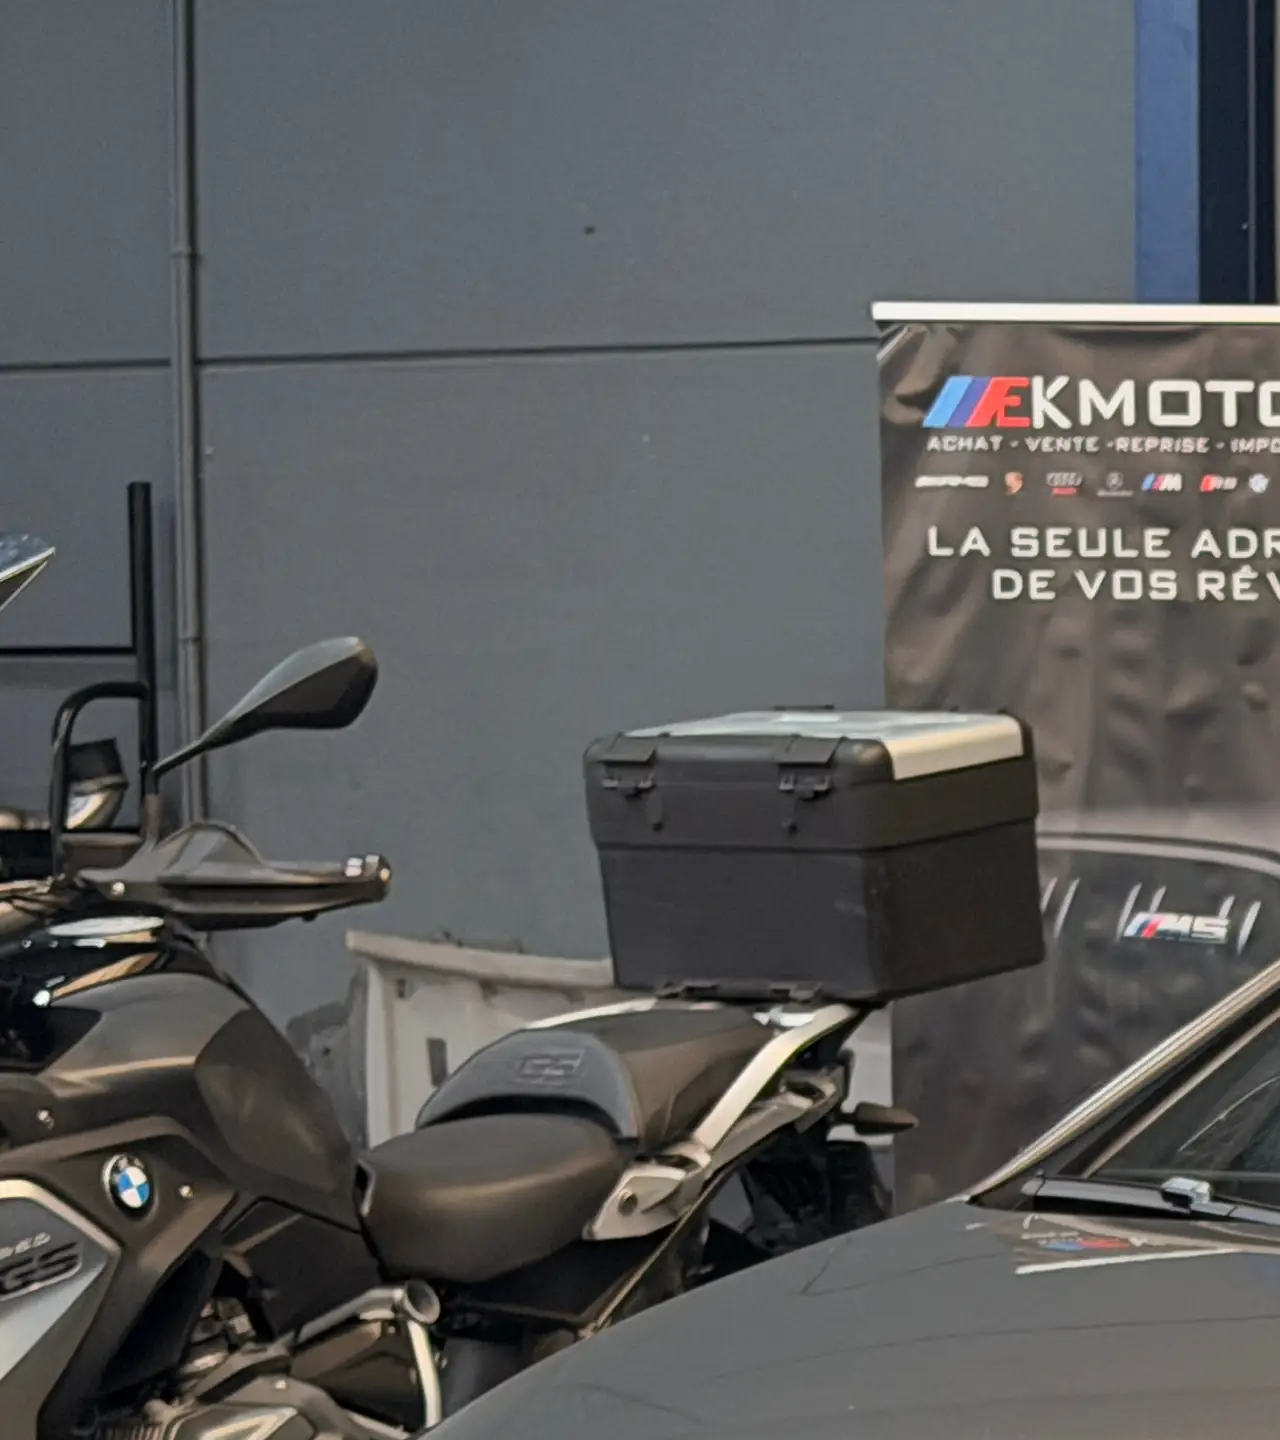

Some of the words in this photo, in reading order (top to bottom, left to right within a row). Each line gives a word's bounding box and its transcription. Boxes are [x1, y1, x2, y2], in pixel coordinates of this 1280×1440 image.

[926, 435, 1003, 452] ACHAT
[1025, 437, 1099, 452] VENTE
[927, 526, 991, 557] LA
[1010, 527, 1171, 558] SEULE
[992, 569, 1056, 600] DE
[1074, 569, 1178, 600] VOS
